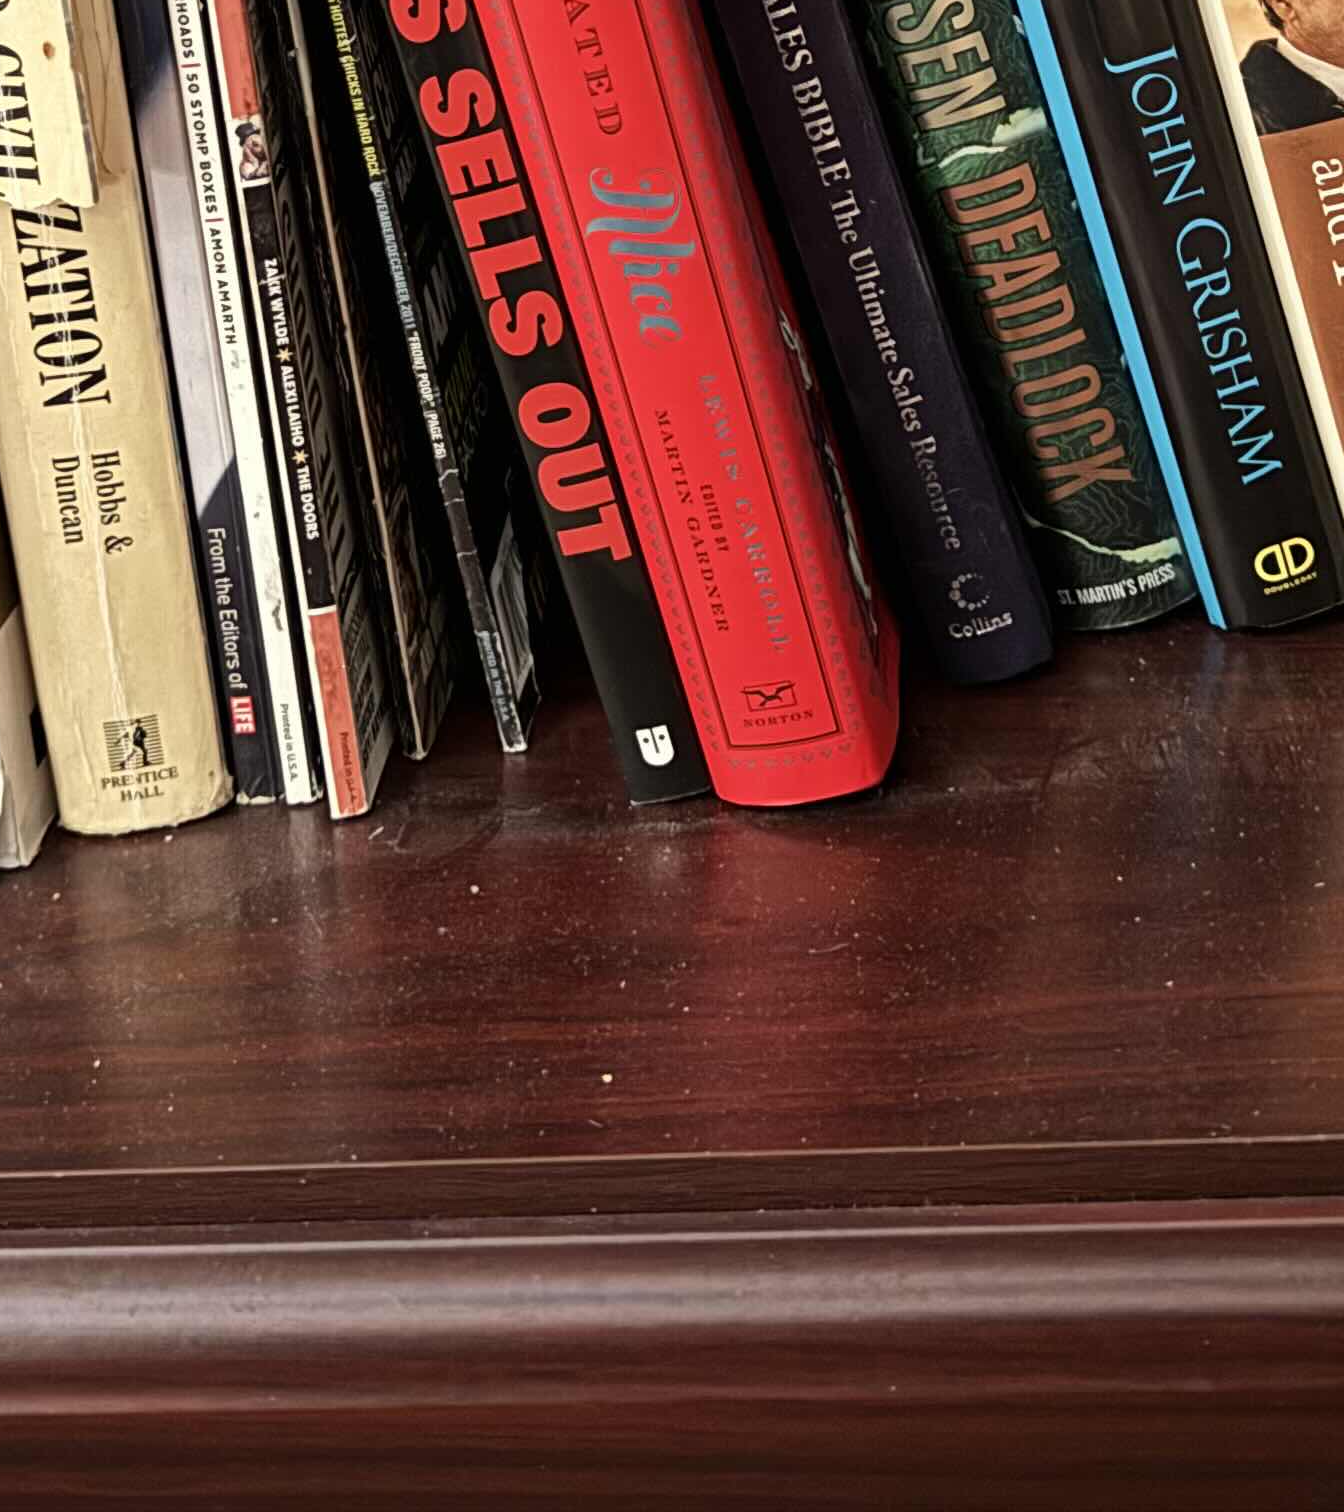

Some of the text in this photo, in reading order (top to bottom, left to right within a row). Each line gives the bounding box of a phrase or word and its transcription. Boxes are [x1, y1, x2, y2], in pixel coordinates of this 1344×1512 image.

[326, 3, 352, 54] HOTTEST
[184, 72, 219, 215] 50 STOMP BOXES
[349, 96, 366, 112] IN
[353, 111, 374, 146] HARD
[787, 75, 852, 190] BIBLE
[361, 145, 381, 177] ROCK
[586, 165, 697, 345] Alice
[824, 187, 866, 247] The
[206, 225, 239, 347] AMON AMARTH
[262, 257, 291, 346] ZAKK WYLDE
[843, 244, 907, 368] Ultimate
[1104, 44, 1283, 487] JOHN GRISHAM
[418, 67, 564, 358] SELLS
[517, 381, 633, 562] OUT
[938, 160, 1134, 505] DEADLOCK
[278, 363, 305, 448] ALEXI LAIHO
[883, 362, 930, 436] Sales
[52, 456, 86, 546] Duncan
[90, 450, 135, 554] Hobbs &
[294, 465, 320, 540] THE DOORS
[655, 409, 731, 634] MARTIN GARDNER
[699, 483, 725, 529] EDITED
[907, 432, 966, 555] Resource
[950, 610, 1012, 640] Collins
[1076, 563, 1176, 606] MARTIN'S PRESS
[206, 525, 256, 737] From the Editors of LIFE
[277, 701, 295, 739] Printed
[743, 708, 815, 730] NORTON
[121, 784, 165, 803] HALL
